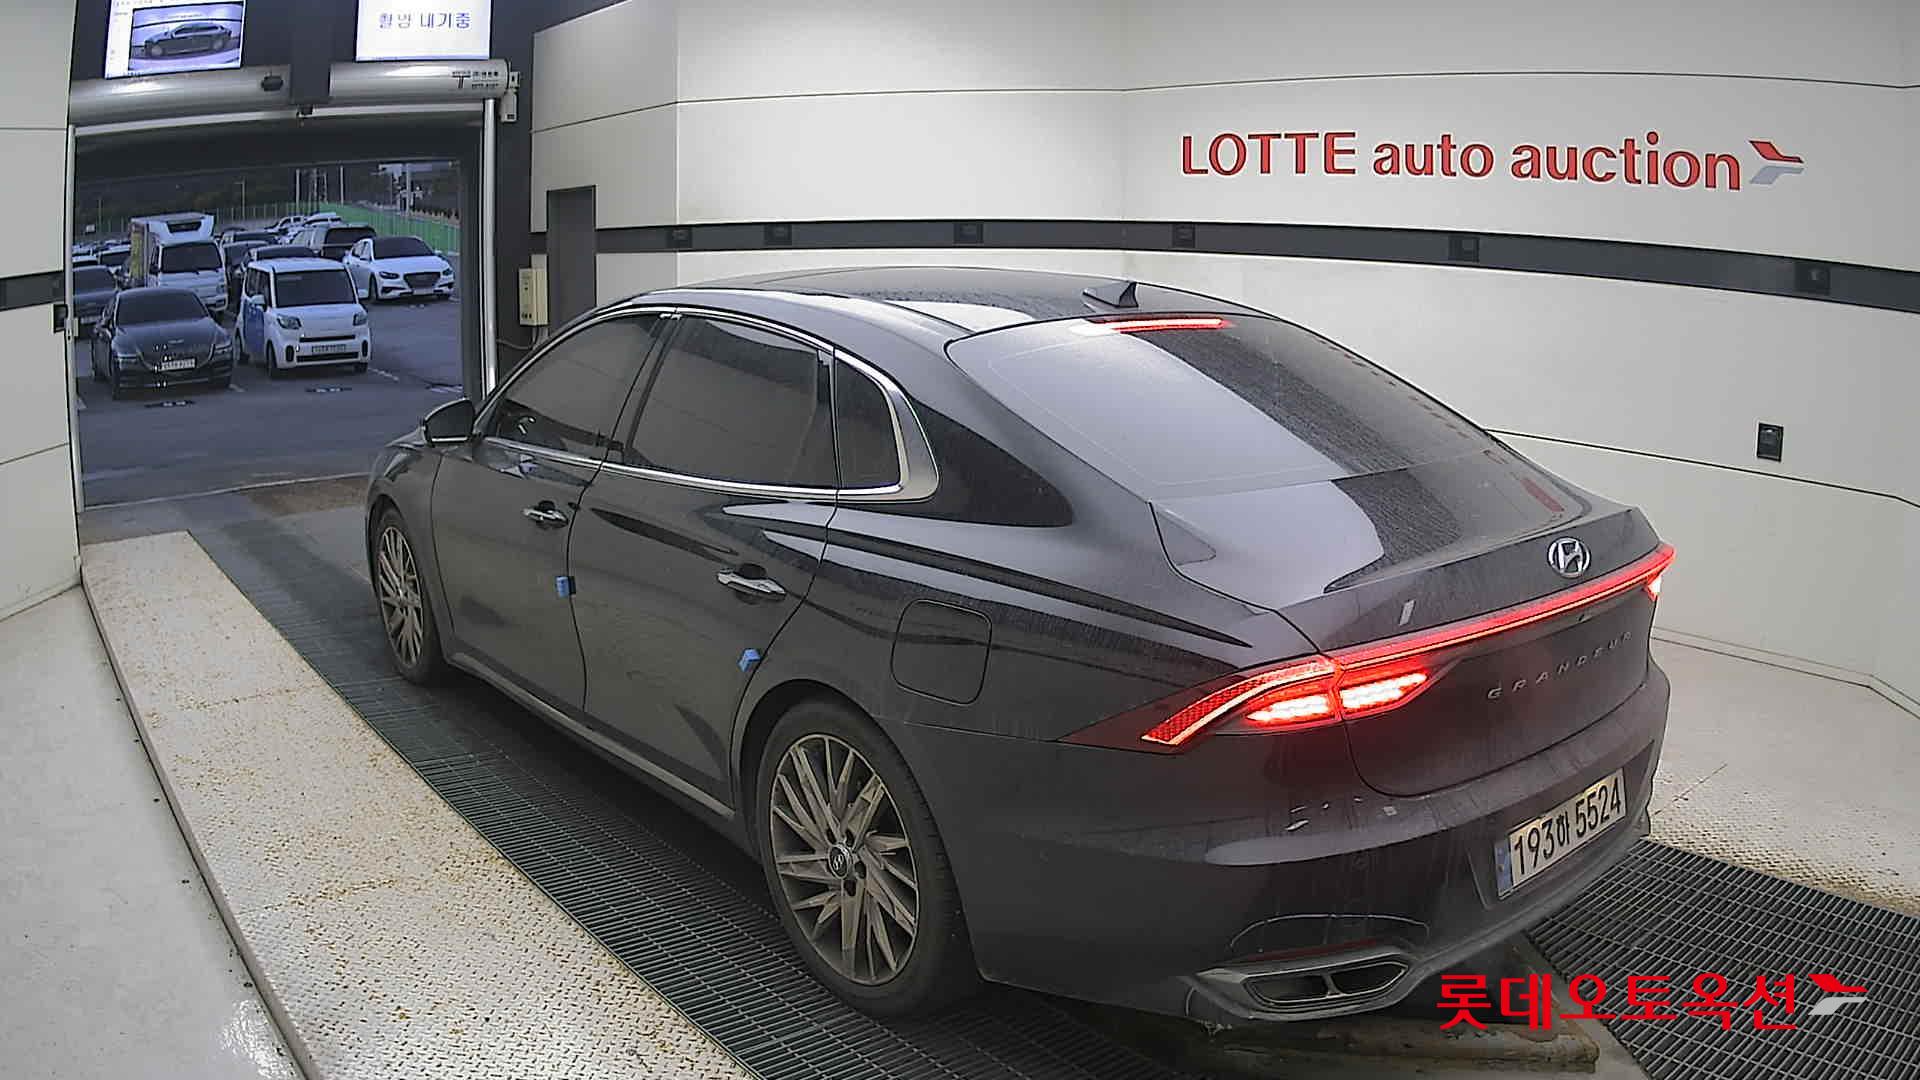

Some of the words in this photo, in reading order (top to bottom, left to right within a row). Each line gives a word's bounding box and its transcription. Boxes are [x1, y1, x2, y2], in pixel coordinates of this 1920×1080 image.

[1182, 132, 1356, 175] LOTTE
[1373, 134, 1494, 177] auto
[1511, 132, 1741, 190] auction
[1487, 631, 1632, 700] GRANDEUR
[1514, 811, 1570, 875] 193하
[1575, 777, 1622, 838] 5524
